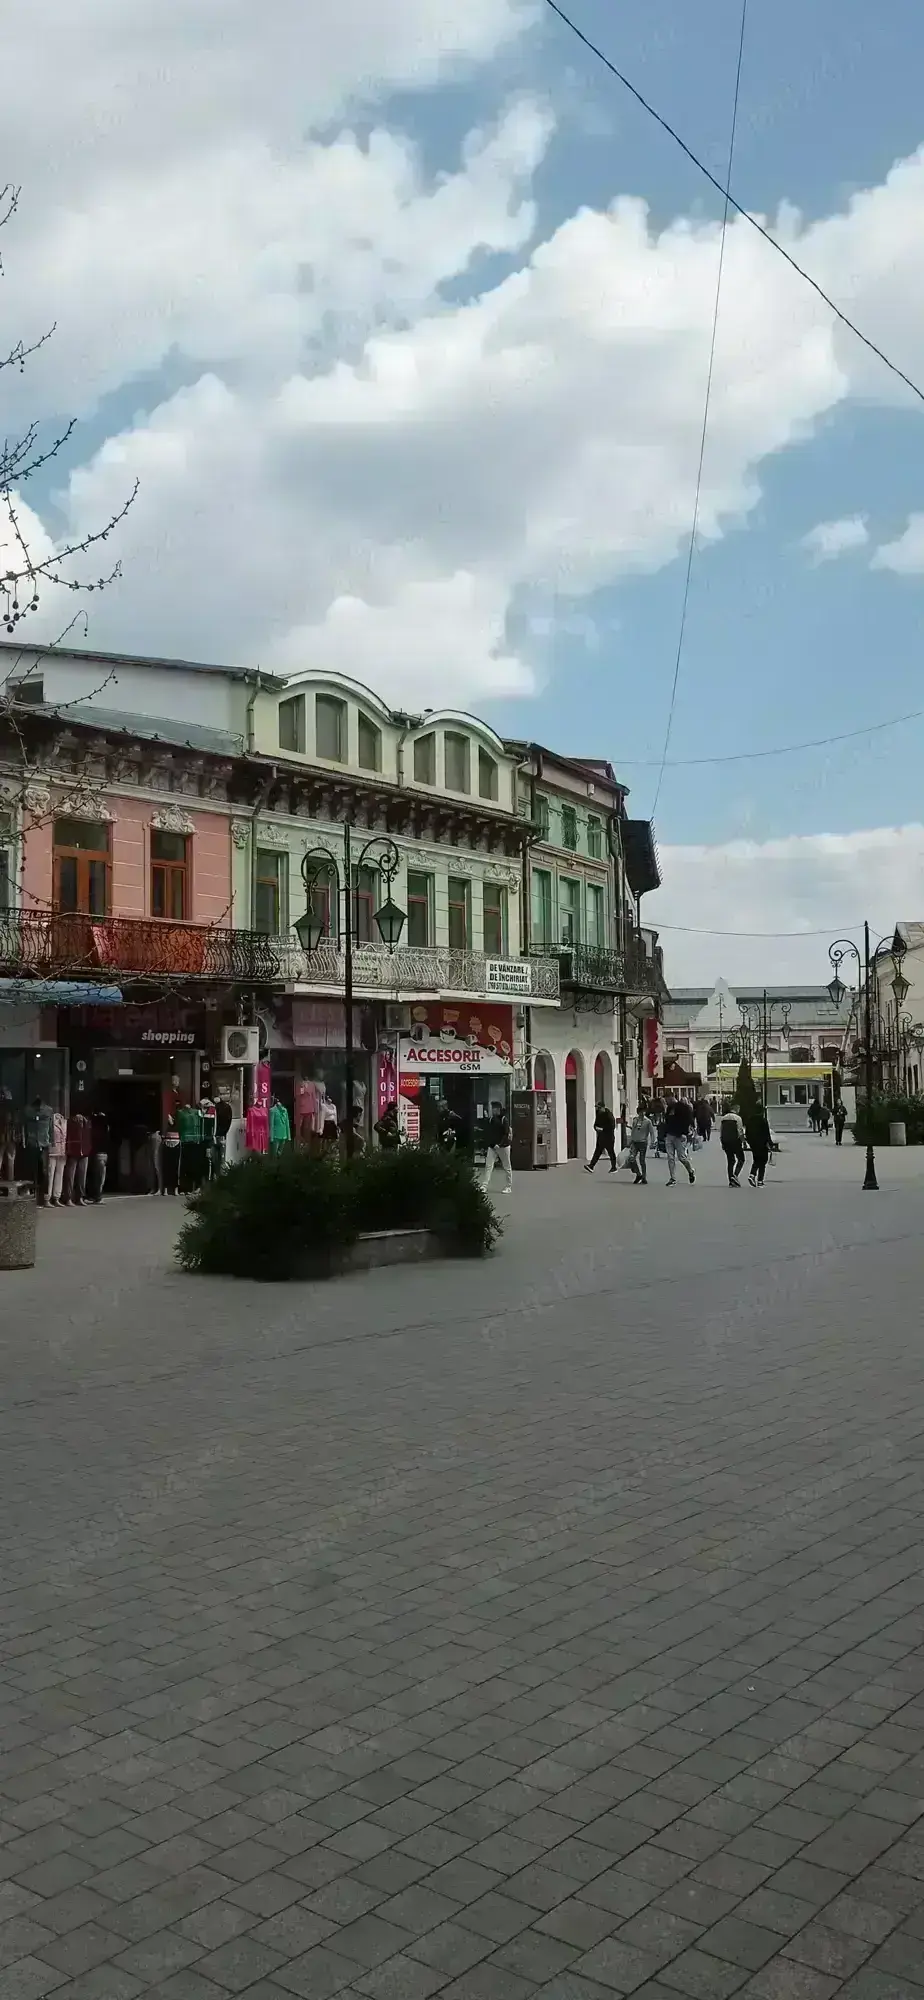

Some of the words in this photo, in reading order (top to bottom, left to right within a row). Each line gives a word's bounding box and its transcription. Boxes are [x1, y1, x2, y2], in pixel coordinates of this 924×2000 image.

[489, 963, 498, 972] DE
[489, 973, 498, 981] DE
[141, 1029, 195, 1044] shopping
[406, 1048, 481, 1062] ACCESORII
[459, 1063, 481, 1071] GSM
